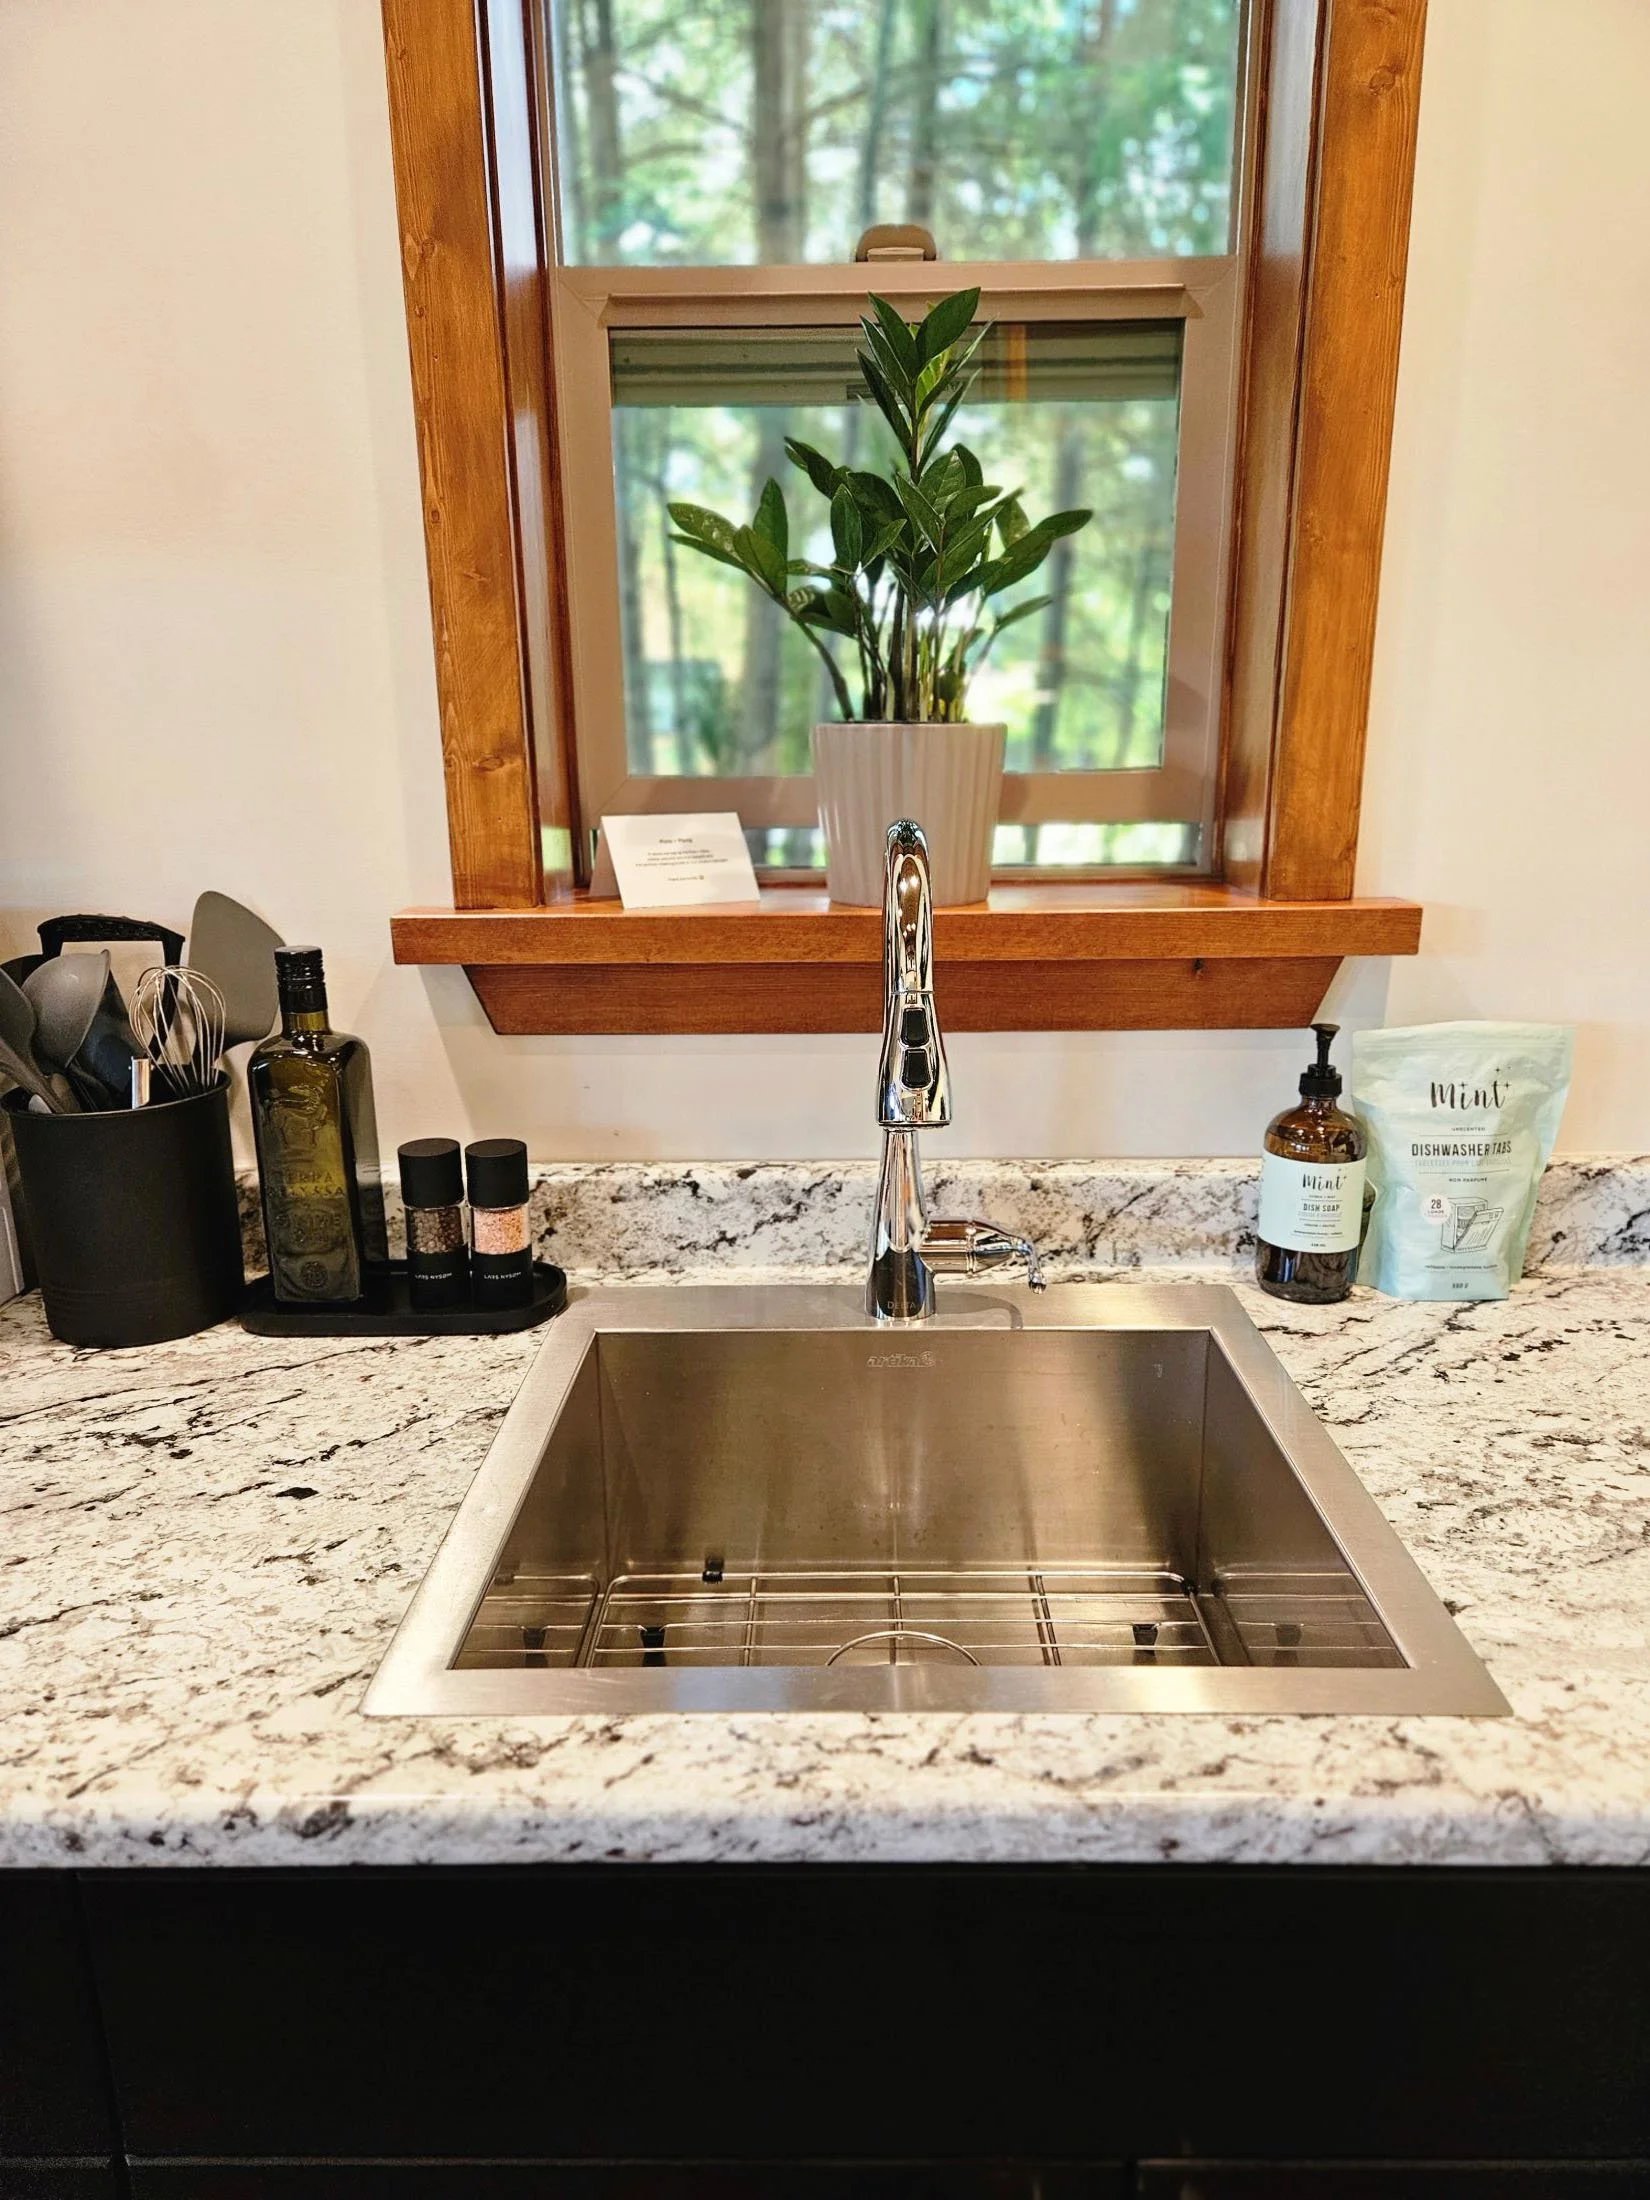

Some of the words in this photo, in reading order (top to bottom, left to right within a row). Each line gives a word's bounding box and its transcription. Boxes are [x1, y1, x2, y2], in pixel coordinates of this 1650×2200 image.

[1411, 1143, 1490, 1157] DISHWASHER
[1492, 1140, 1512, 1155] TABS
[1303, 1203, 1321, 1212] DISH
[1322, 1203, 1341, 1212] SOAP
[1431, 1198, 1442, 1210] 28
